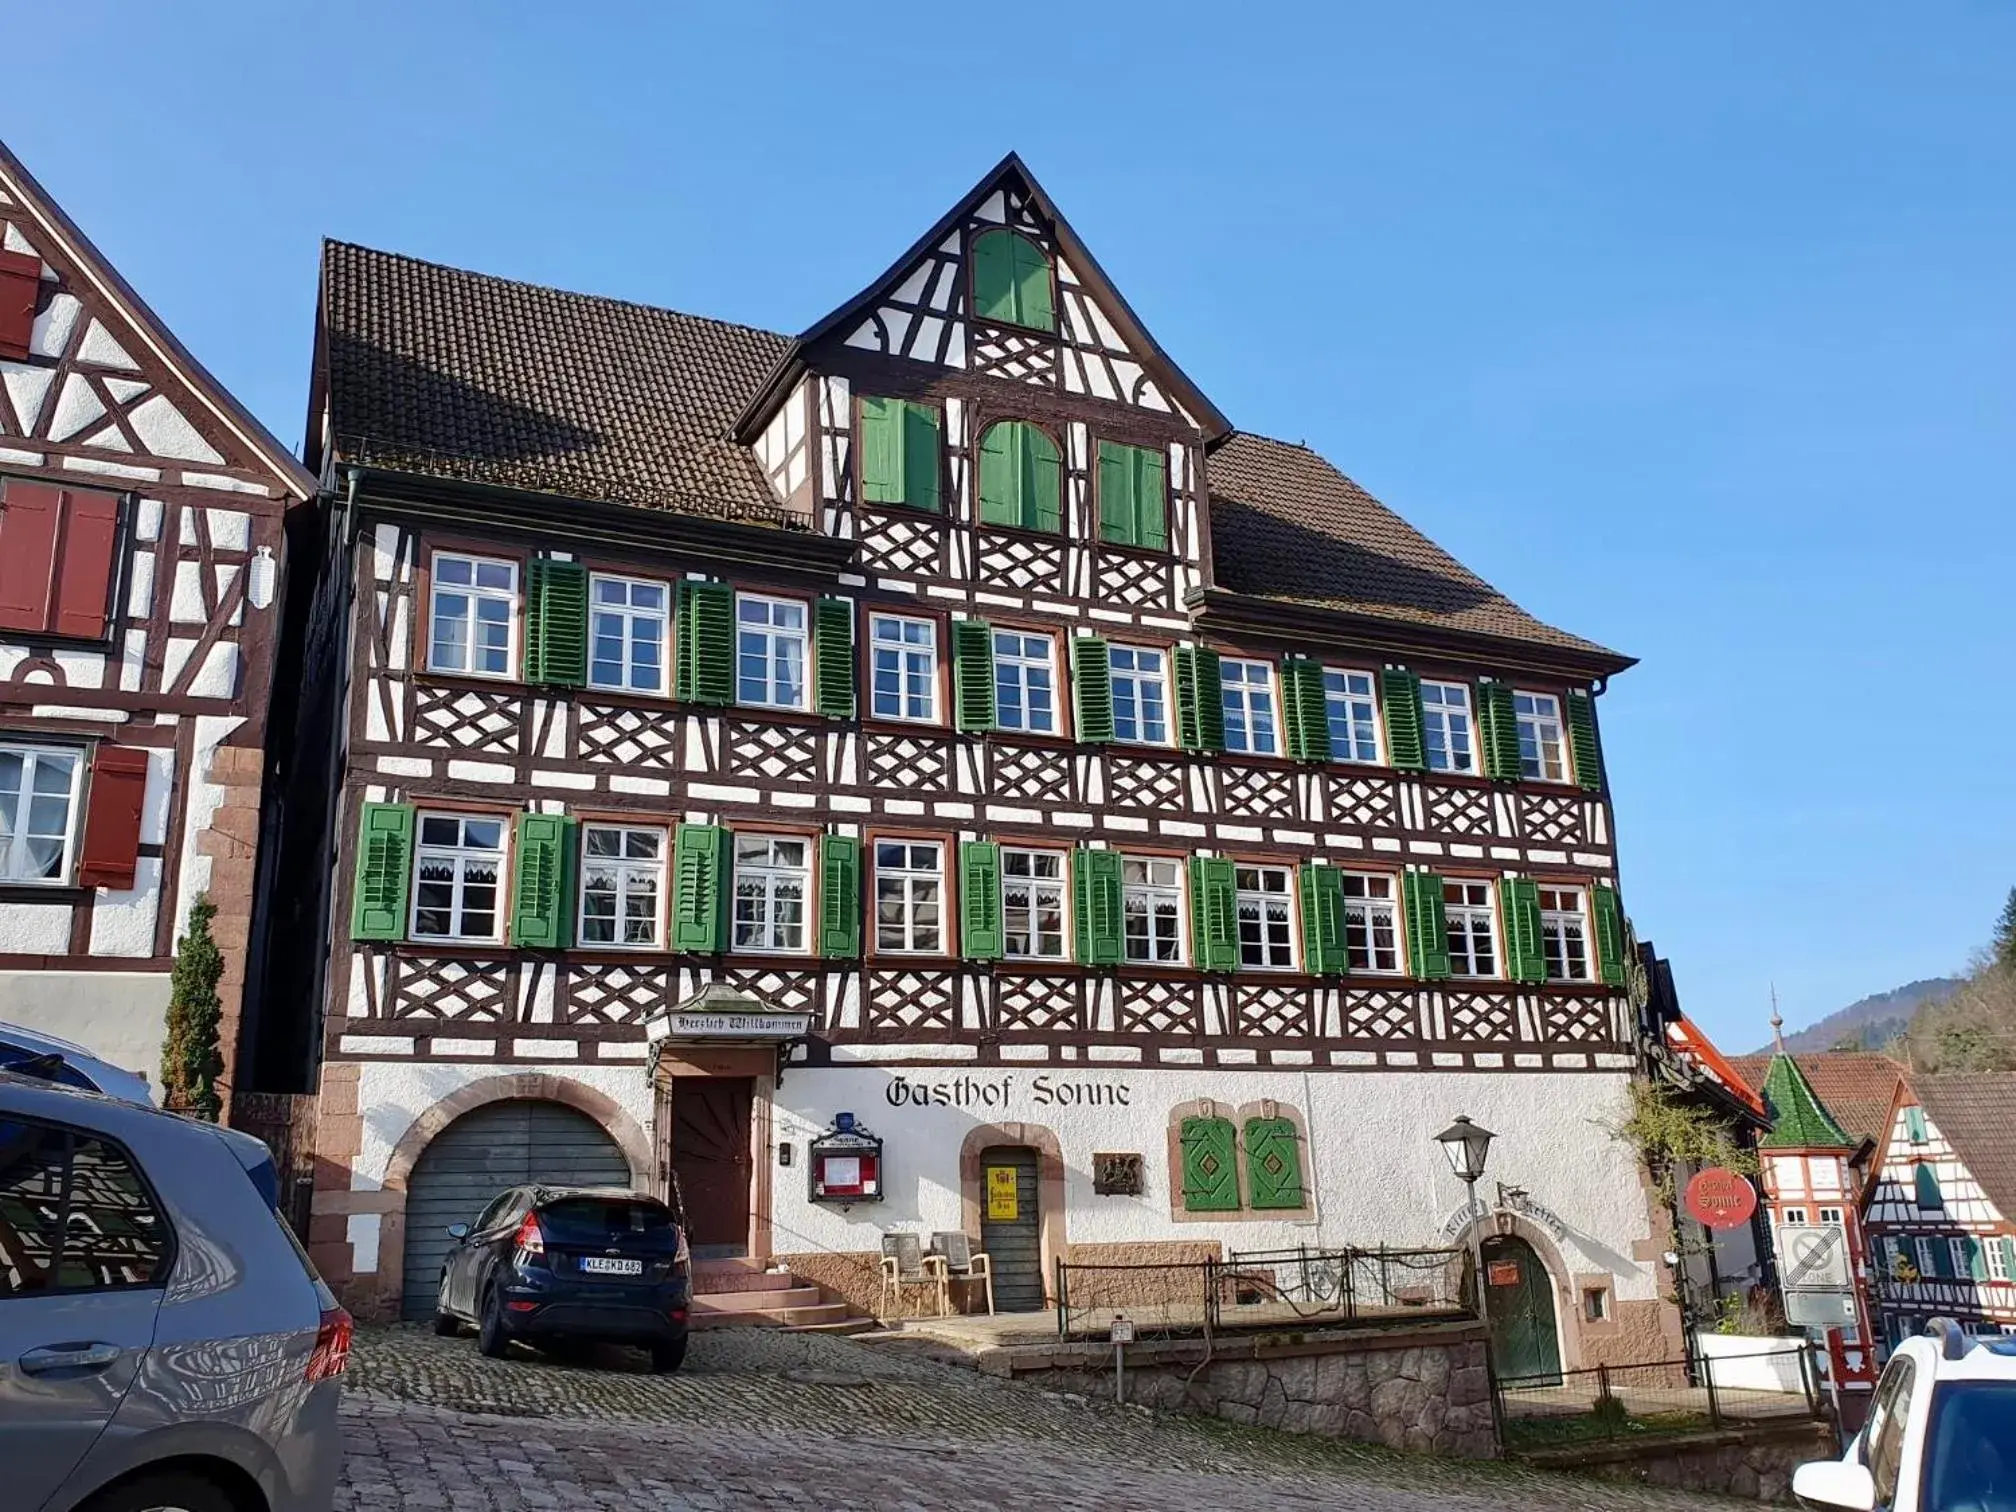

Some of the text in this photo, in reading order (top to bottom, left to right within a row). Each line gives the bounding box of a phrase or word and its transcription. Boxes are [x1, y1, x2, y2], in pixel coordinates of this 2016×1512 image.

[729, 1016, 802, 1030] Willkommen
[886, 1075, 1130, 1108] Gasthof Sonne
